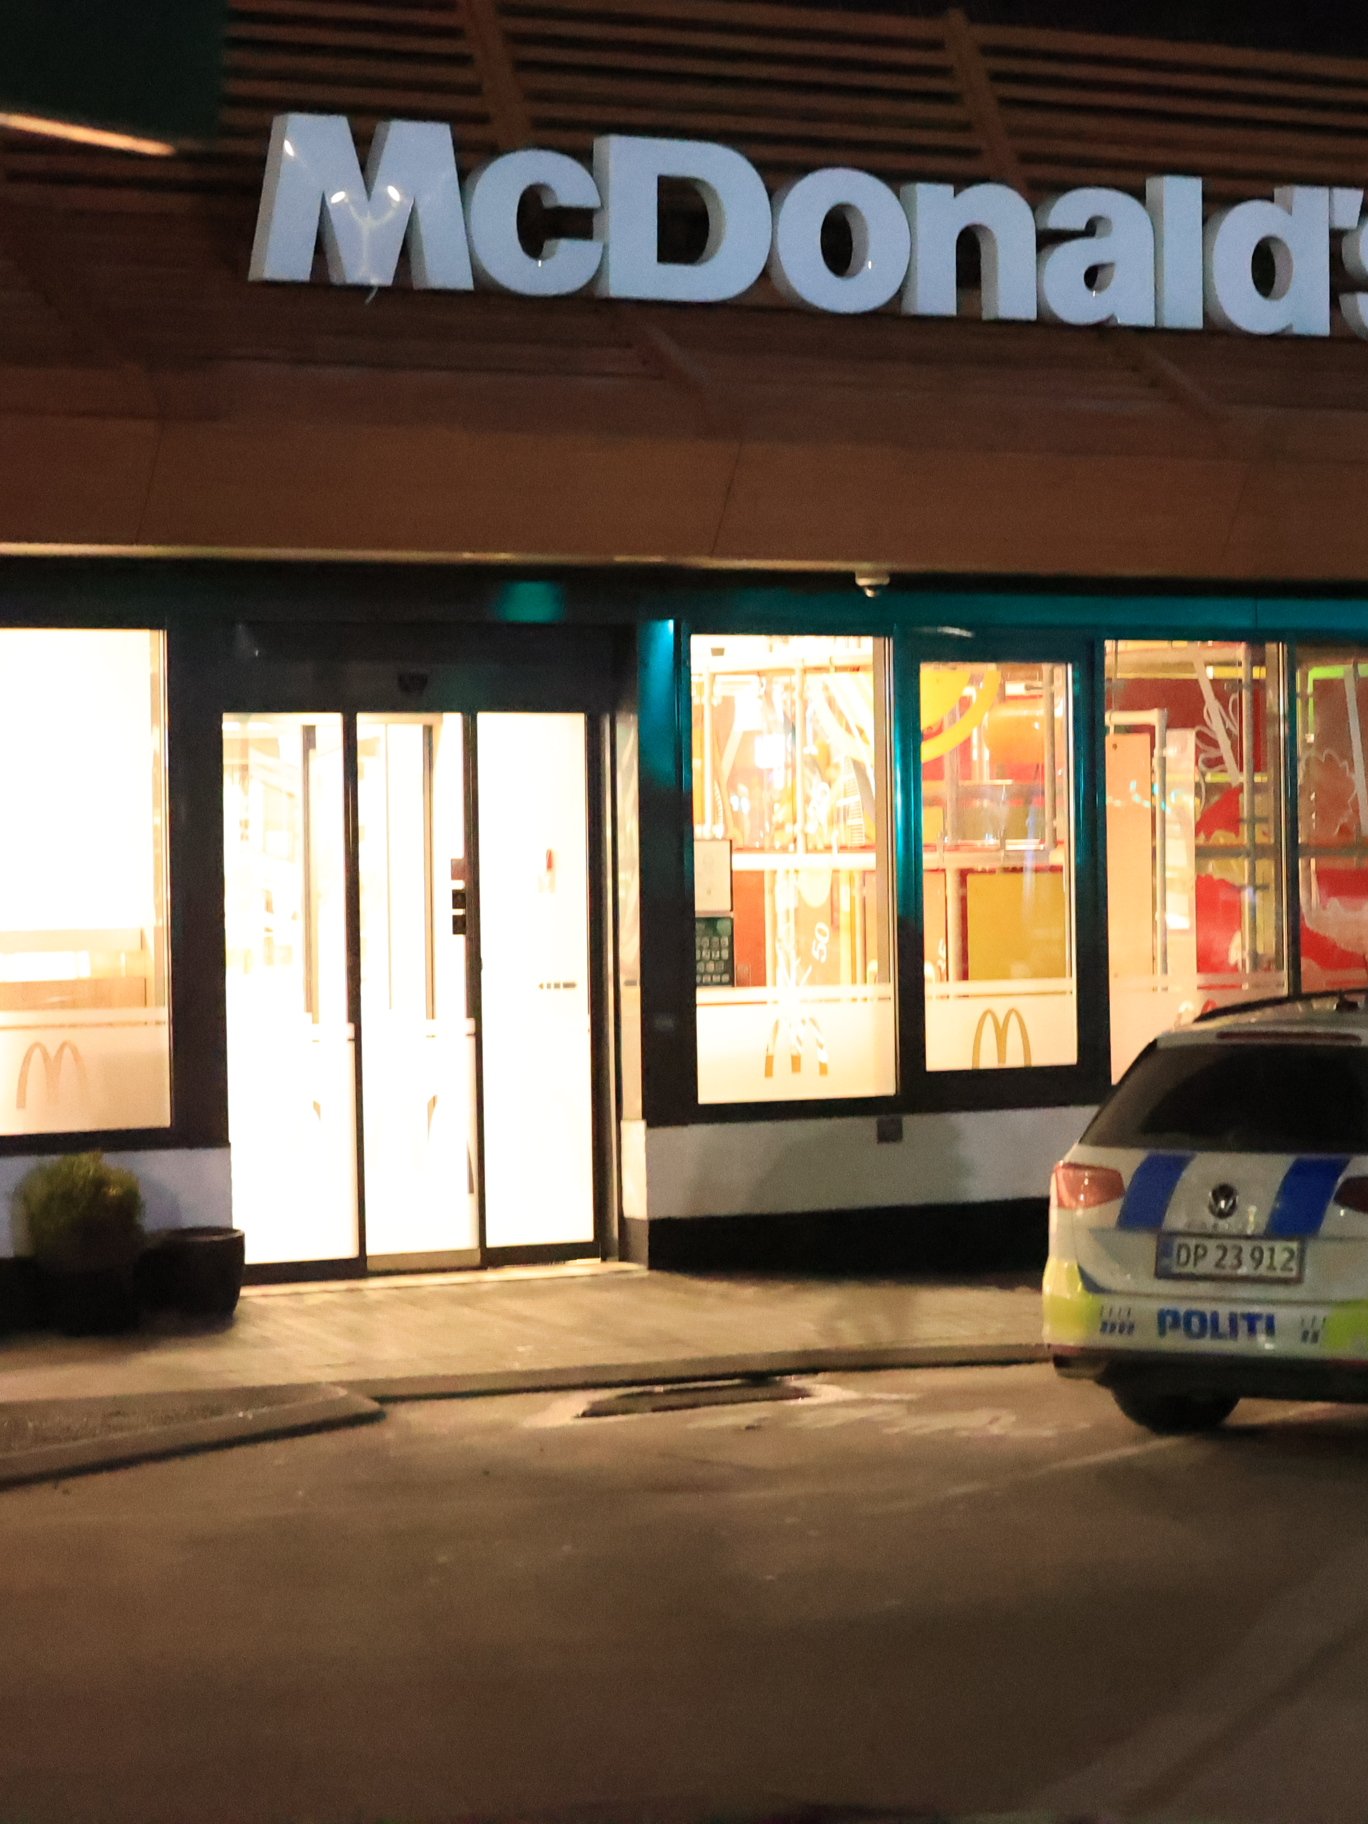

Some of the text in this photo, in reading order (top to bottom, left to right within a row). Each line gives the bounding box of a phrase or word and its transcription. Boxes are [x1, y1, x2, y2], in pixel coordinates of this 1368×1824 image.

[1176, 1242, 1296, 1273] DP 23 912
[1157, 1308, 1276, 1340] POLITI
